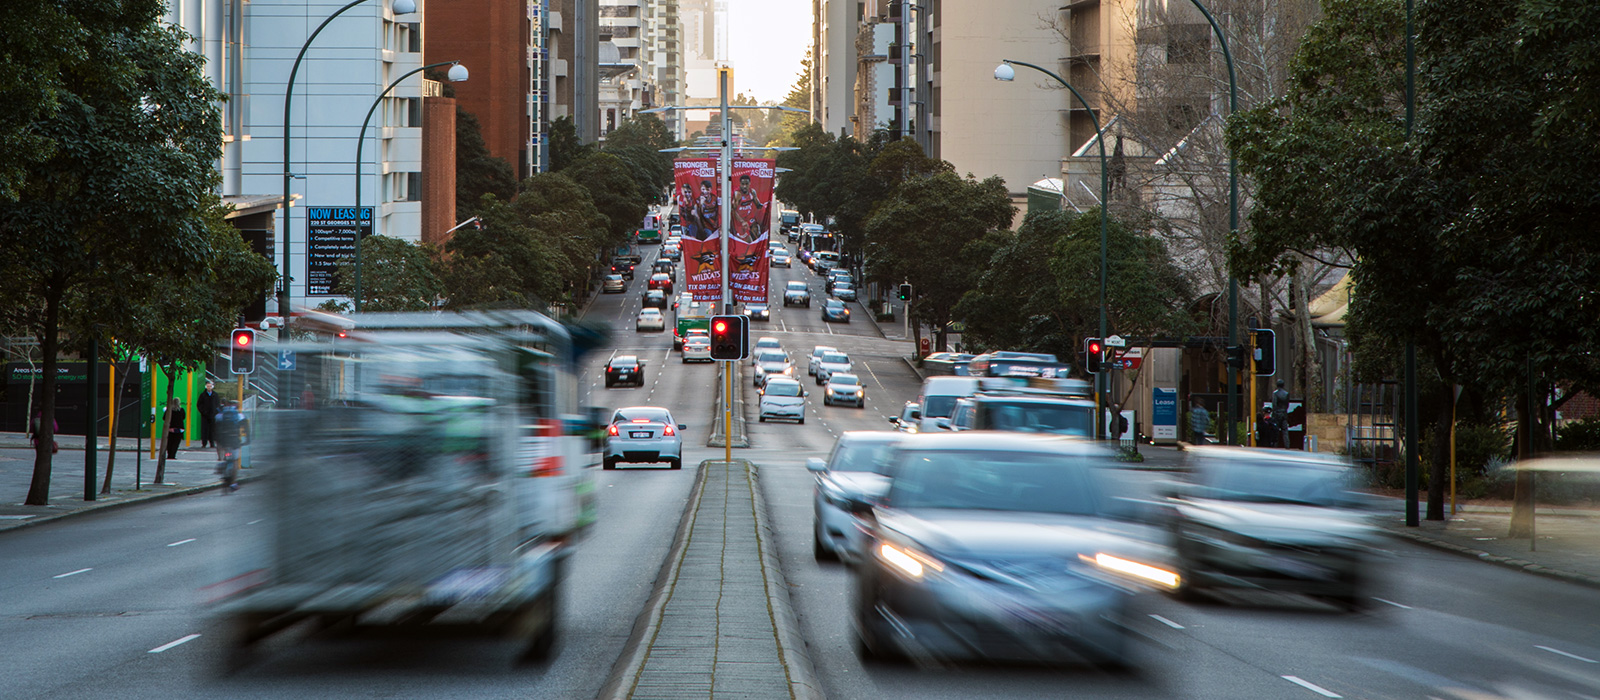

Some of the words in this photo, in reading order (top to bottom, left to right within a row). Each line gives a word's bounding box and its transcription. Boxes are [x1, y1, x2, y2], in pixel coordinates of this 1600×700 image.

[734, 161, 768, 169] STRONGER
[759, 169, 773, 177] ONE
[310, 208, 331, 219] NOW
[692, 271, 720, 281] WILDCATS
[282, 349, 292, 358] P
